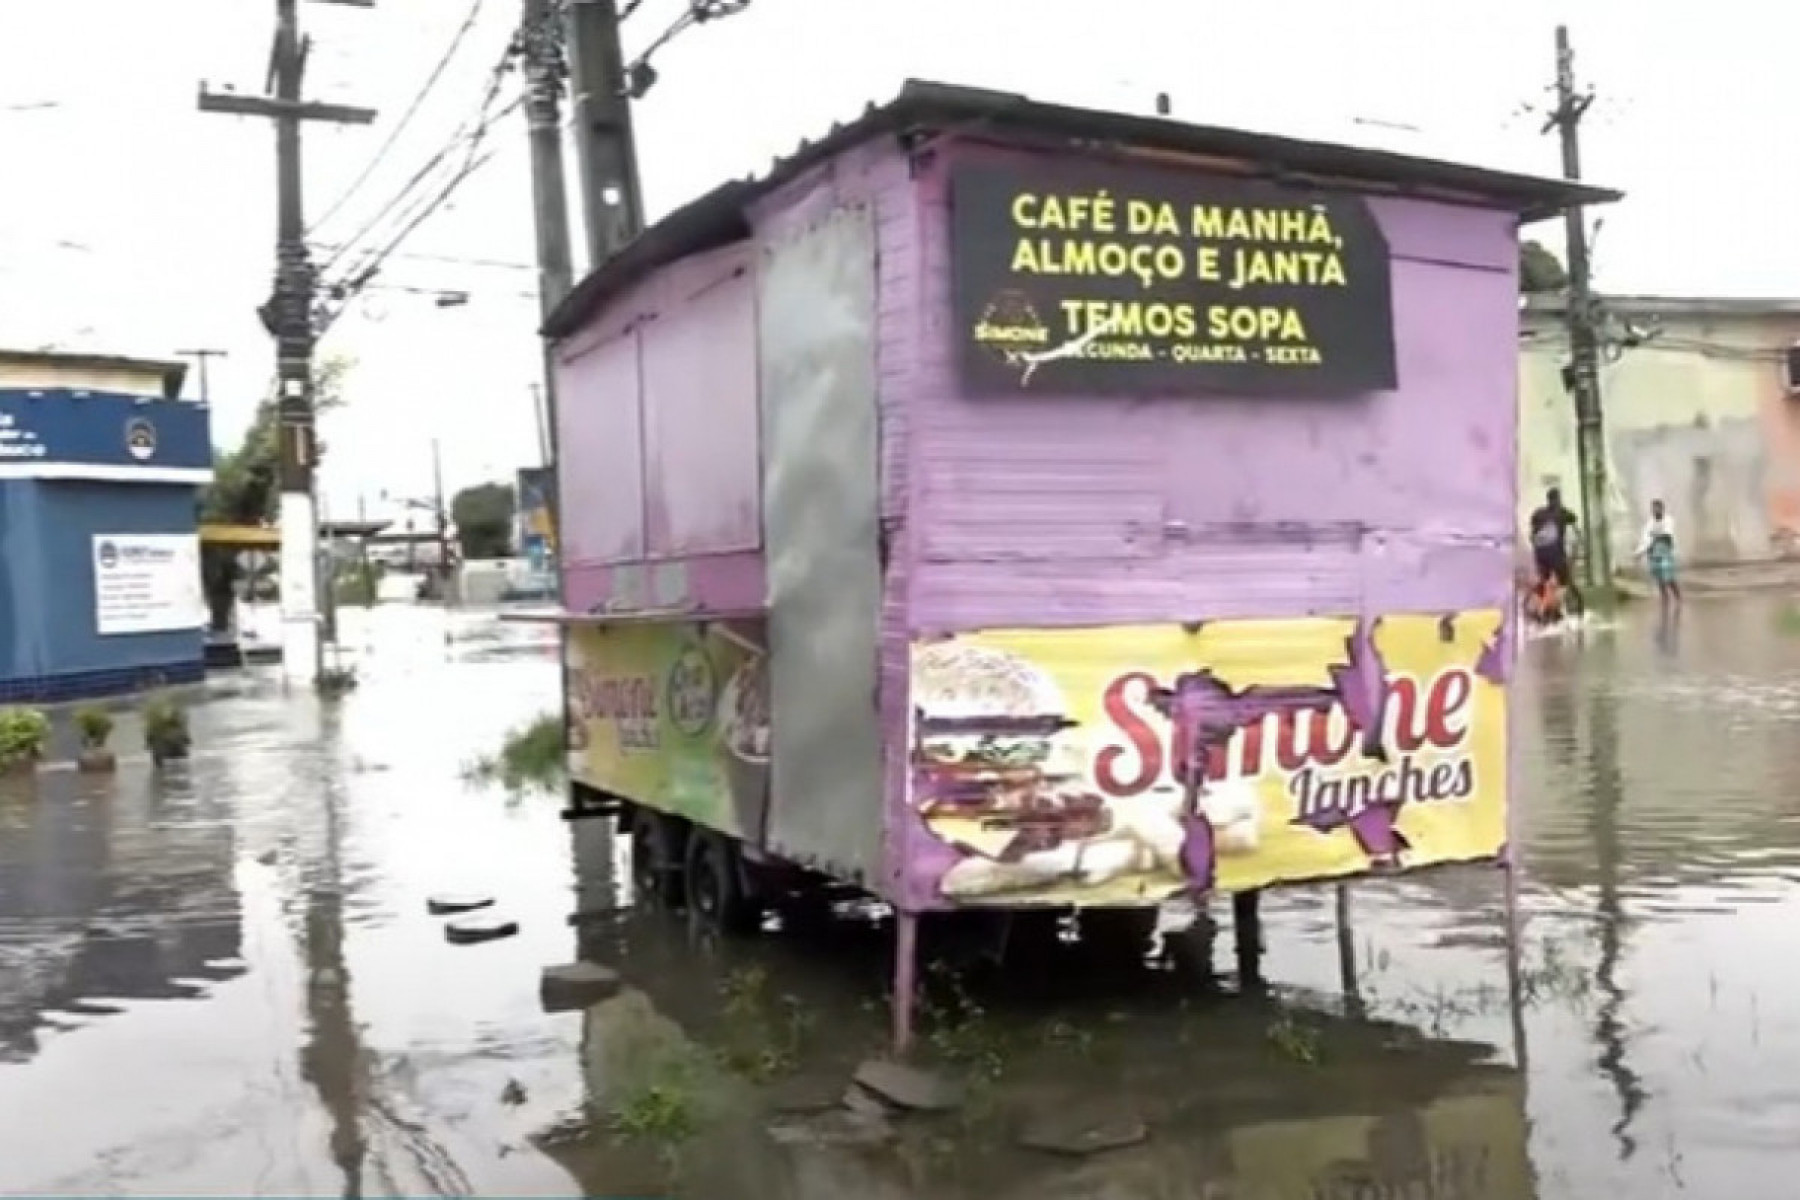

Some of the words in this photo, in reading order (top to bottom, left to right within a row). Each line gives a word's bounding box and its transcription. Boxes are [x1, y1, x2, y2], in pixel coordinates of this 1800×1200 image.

[1012, 190, 1116, 232] CAFÉ
[1127, 203, 1180, 235] DA
[1192, 205, 1343, 248] MANHÃ,
[1011, 240, 1185, 288] ALMOÇO
[1199, 247, 1220, 282] E
[1228, 253, 1347, 289] JANTA
[1061, 299, 1196, 337] TEMOS
[1208, 307, 1305, 340] SOPA
[1172, 343, 1247, 364] QUARTA
[1265, 346, 1323, 364] SEXTA
[1290, 756, 1472, 820] Lanches
